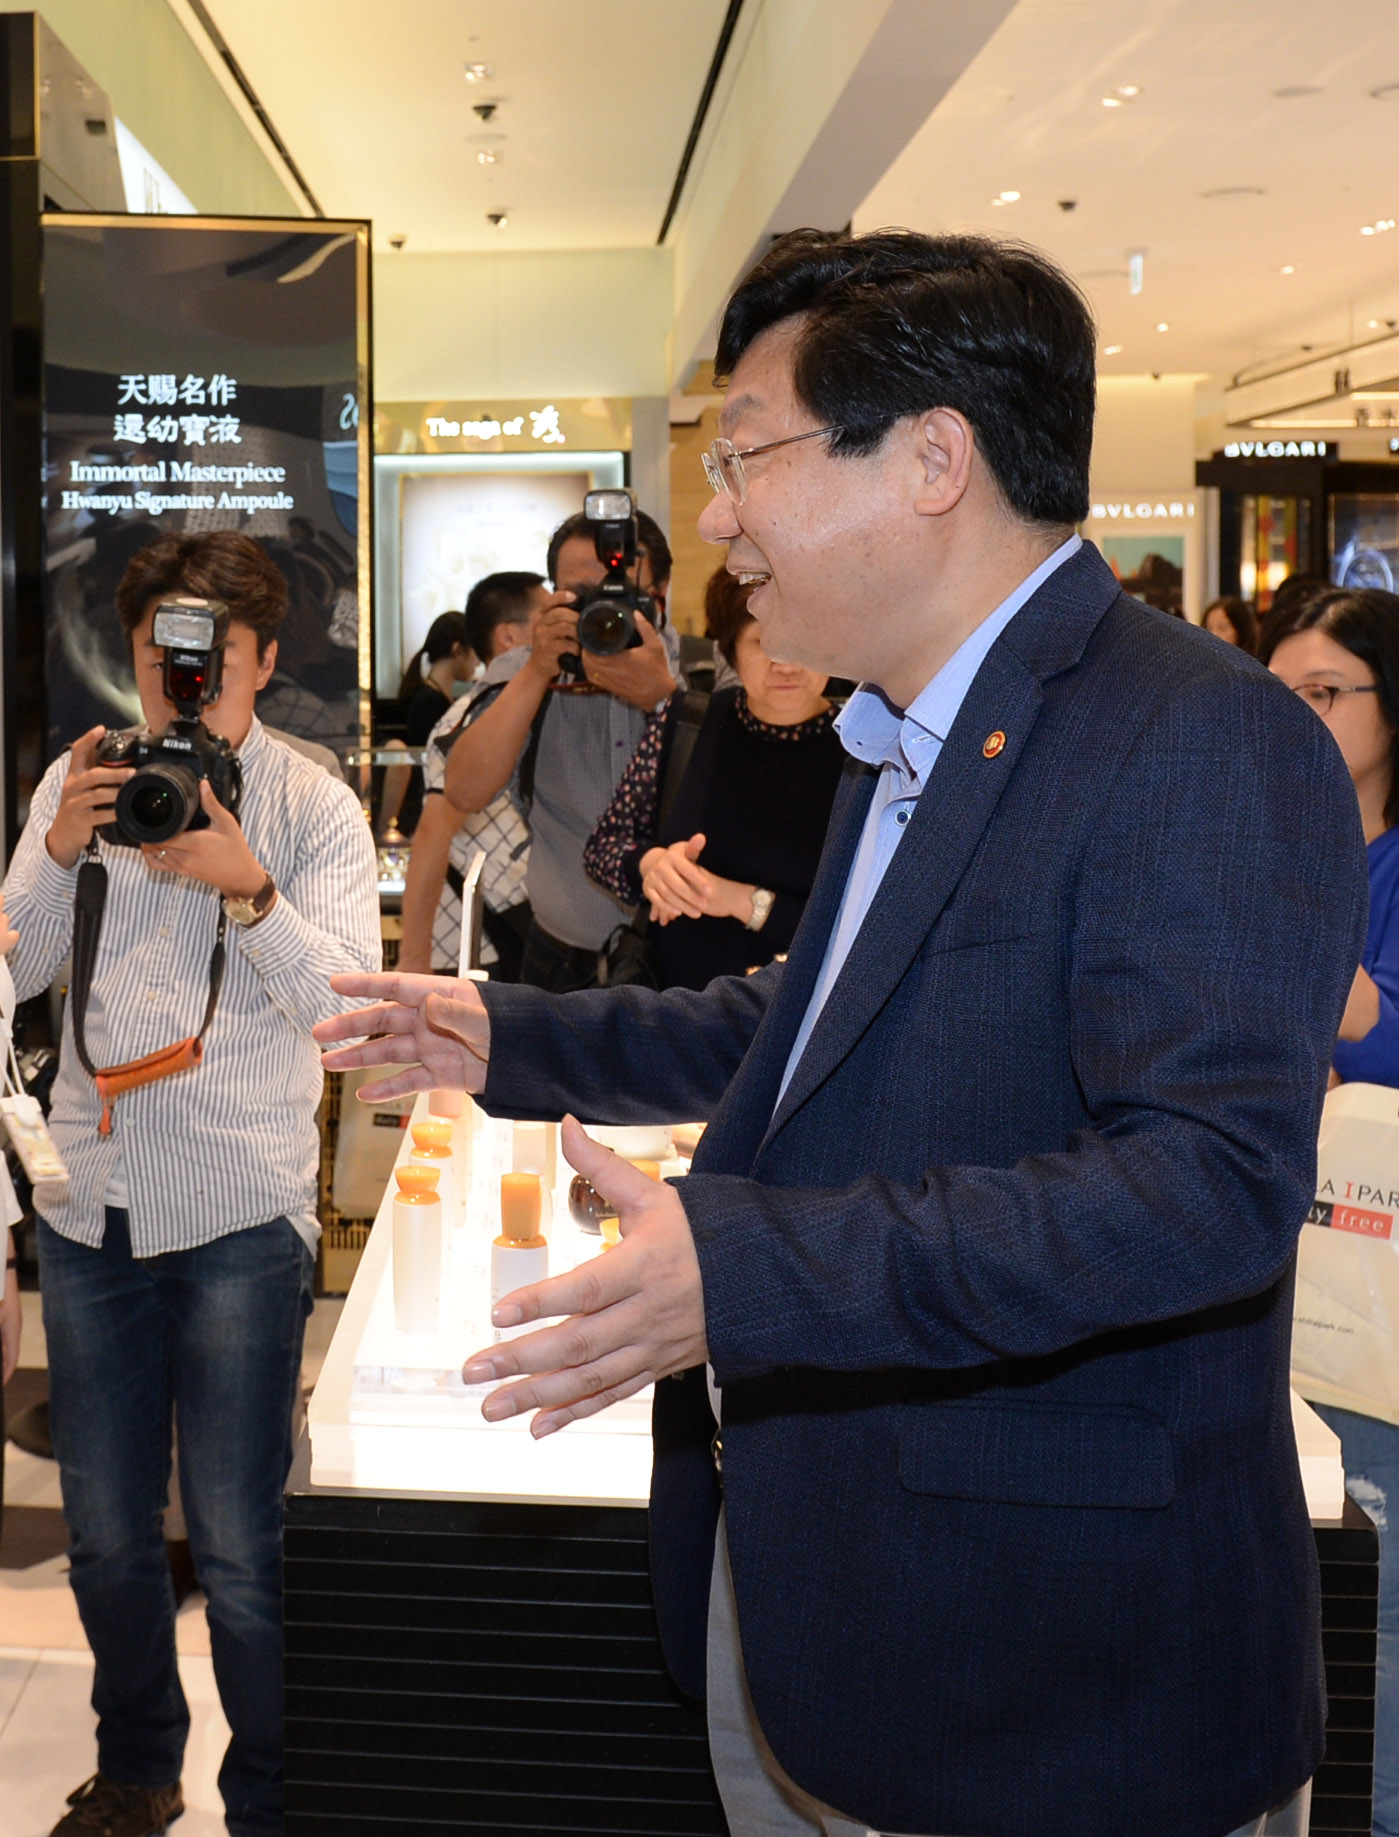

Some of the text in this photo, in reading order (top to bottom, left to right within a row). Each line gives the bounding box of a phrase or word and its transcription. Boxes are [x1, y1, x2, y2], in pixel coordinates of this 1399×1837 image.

[425, 417, 460, 437] The
[502, 416, 525, 436] of
[1224, 440, 1327, 458] BVLGARI
[69, 460, 167, 482] Immortal
[169, 461, 287, 489] Masterpiece
[61, 490, 133, 515] Hwanyu
[134, 490, 215, 515] Signature
[216, 491, 295, 515] Ampoule
[1091, 502, 1195, 519] BVLGARI
[162, 738, 193, 751] Nikon
[1340, 1208, 1385, 1233] free
